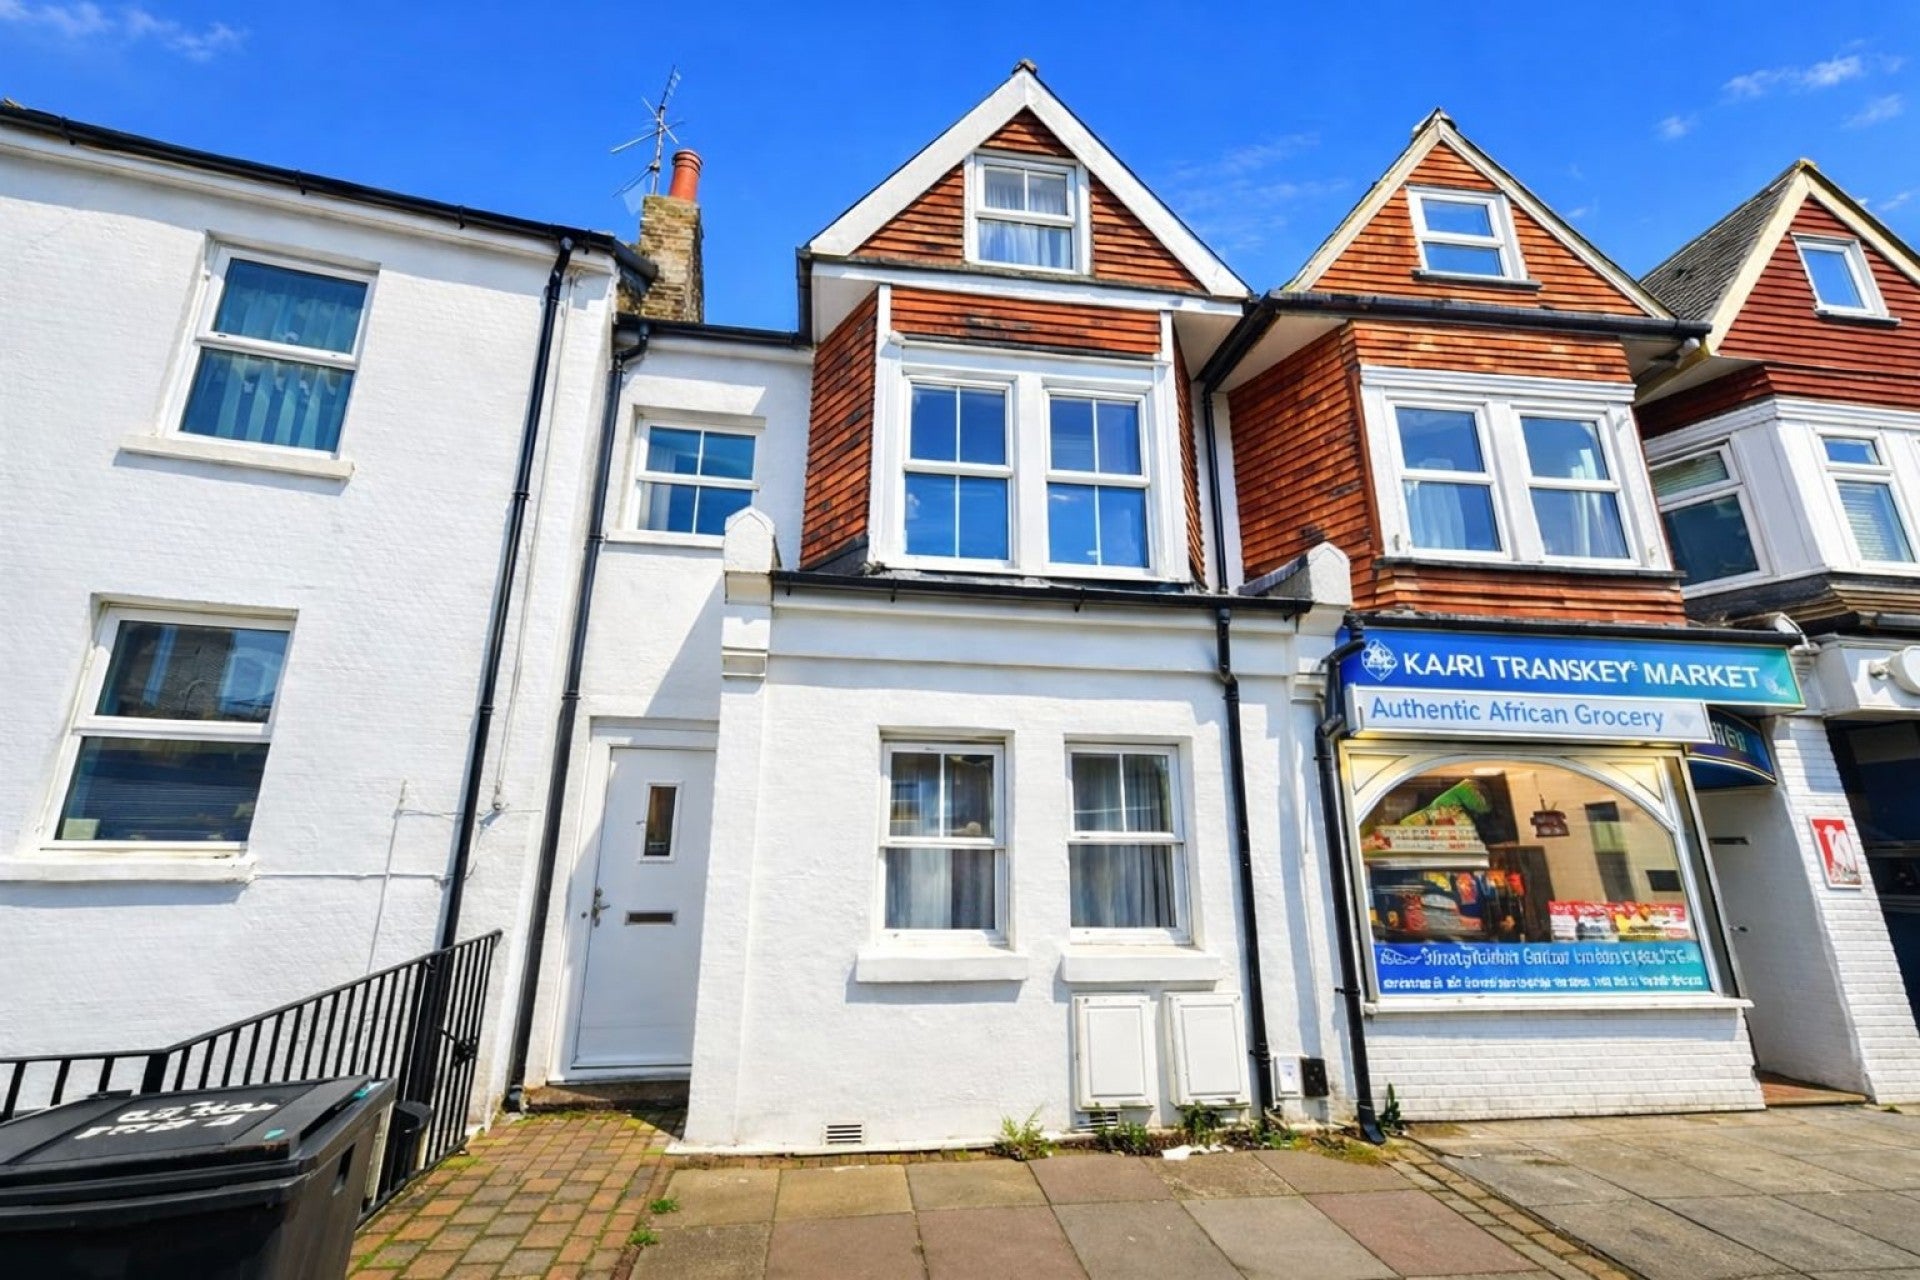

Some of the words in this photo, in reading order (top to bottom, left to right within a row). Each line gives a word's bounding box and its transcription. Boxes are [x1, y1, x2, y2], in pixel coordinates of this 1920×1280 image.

[1642, 662, 1760, 689] MARKET
[1371, 697, 1481, 721] Authentic
[1489, 701, 1569, 725] African
[1575, 704, 1664, 733] Grocery
